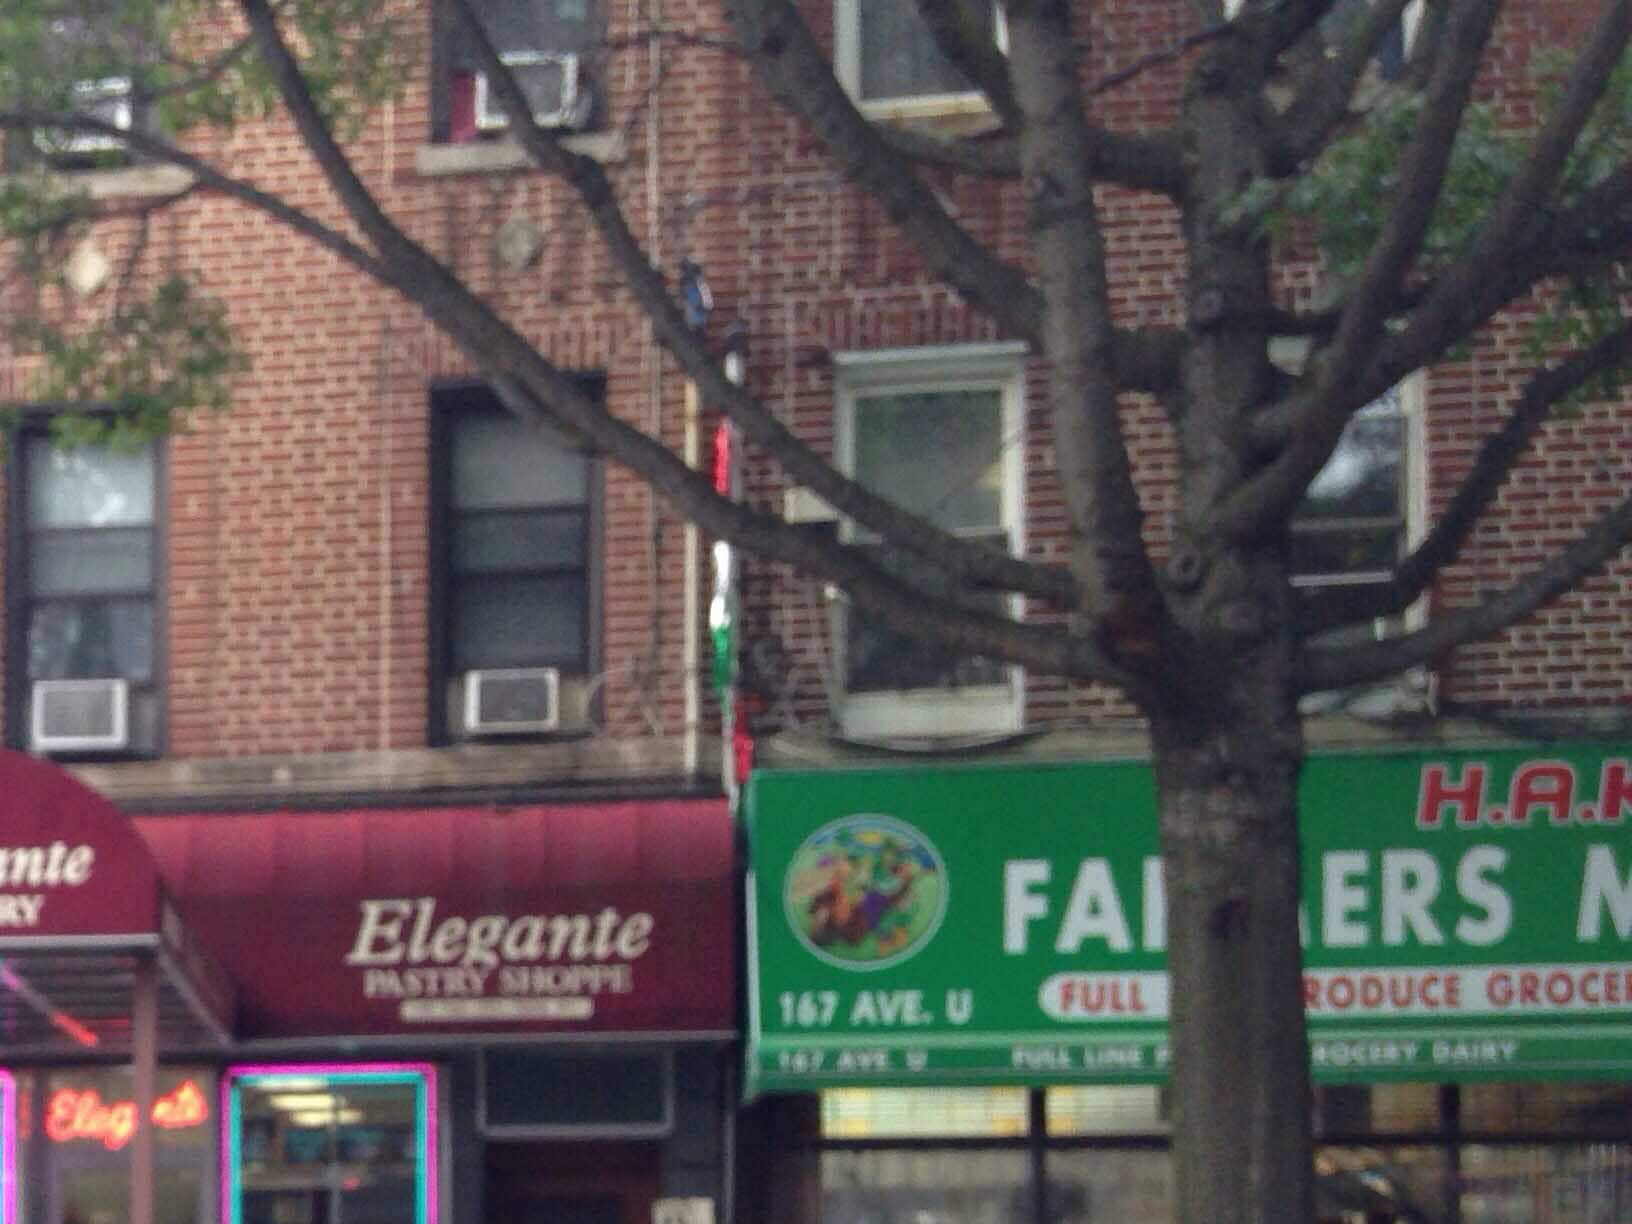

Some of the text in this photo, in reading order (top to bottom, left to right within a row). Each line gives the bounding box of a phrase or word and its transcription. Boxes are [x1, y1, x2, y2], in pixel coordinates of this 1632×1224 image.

[1002, 843, 1632, 956] FAERS M
[348, 897, 654, 973] Elegante
[778, 990, 840, 1026] 167
[945, 988, 974, 1025] U
[1059, 979, 1147, 1014] FULL
[1300, 968, 1632, 1010] RODUCE GROCE
